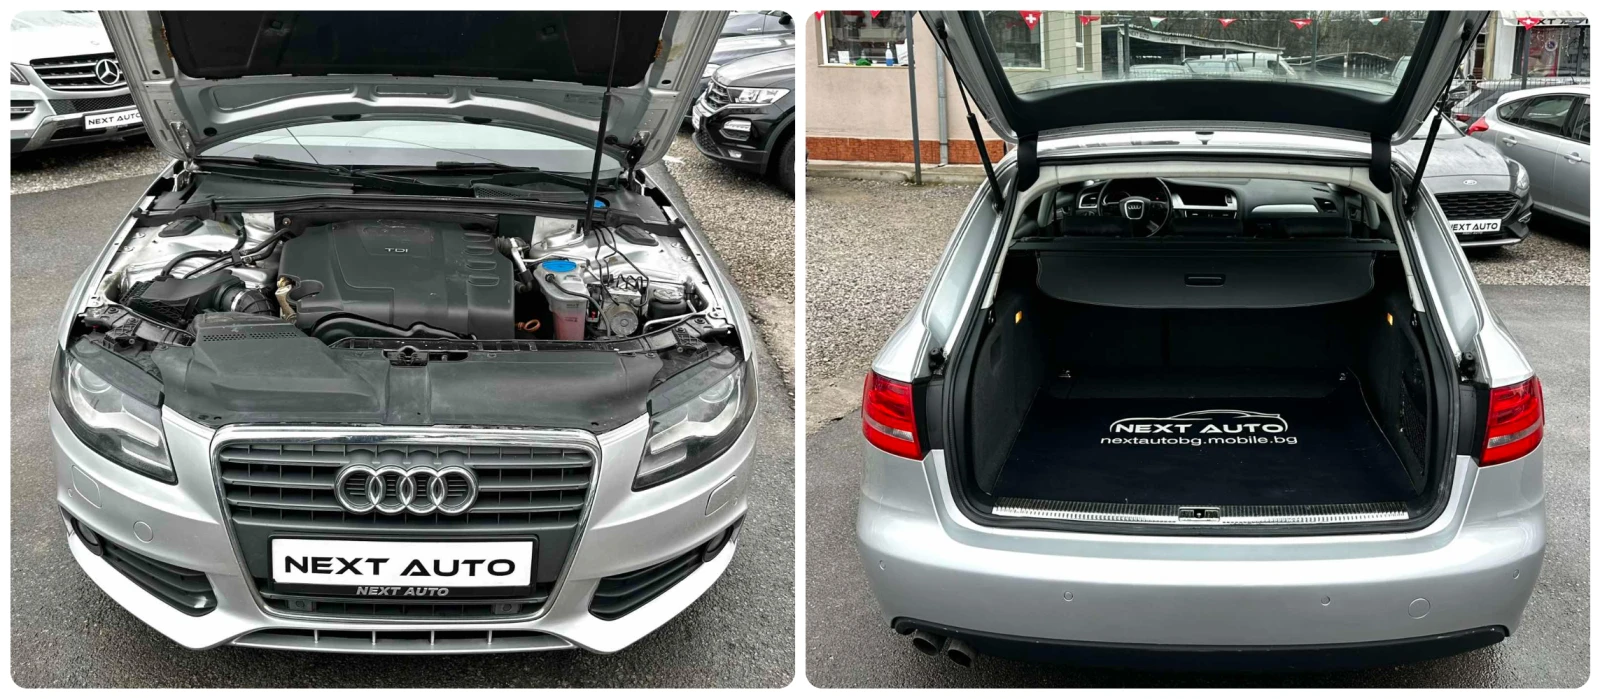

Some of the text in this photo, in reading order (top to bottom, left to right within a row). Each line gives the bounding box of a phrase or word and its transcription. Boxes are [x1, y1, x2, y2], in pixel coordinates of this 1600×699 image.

[88, 113, 141, 125] NEXT AUTO
[1472, 222, 1498, 231] AUTO
[1115, 423, 1284, 434] NEXT AUTO
[1100, 435, 1297, 446] nextautobg.mobile.bg
[285, 555, 516, 577] NEXT AUTO
[356, 586, 449, 597] NEXT AUTO
